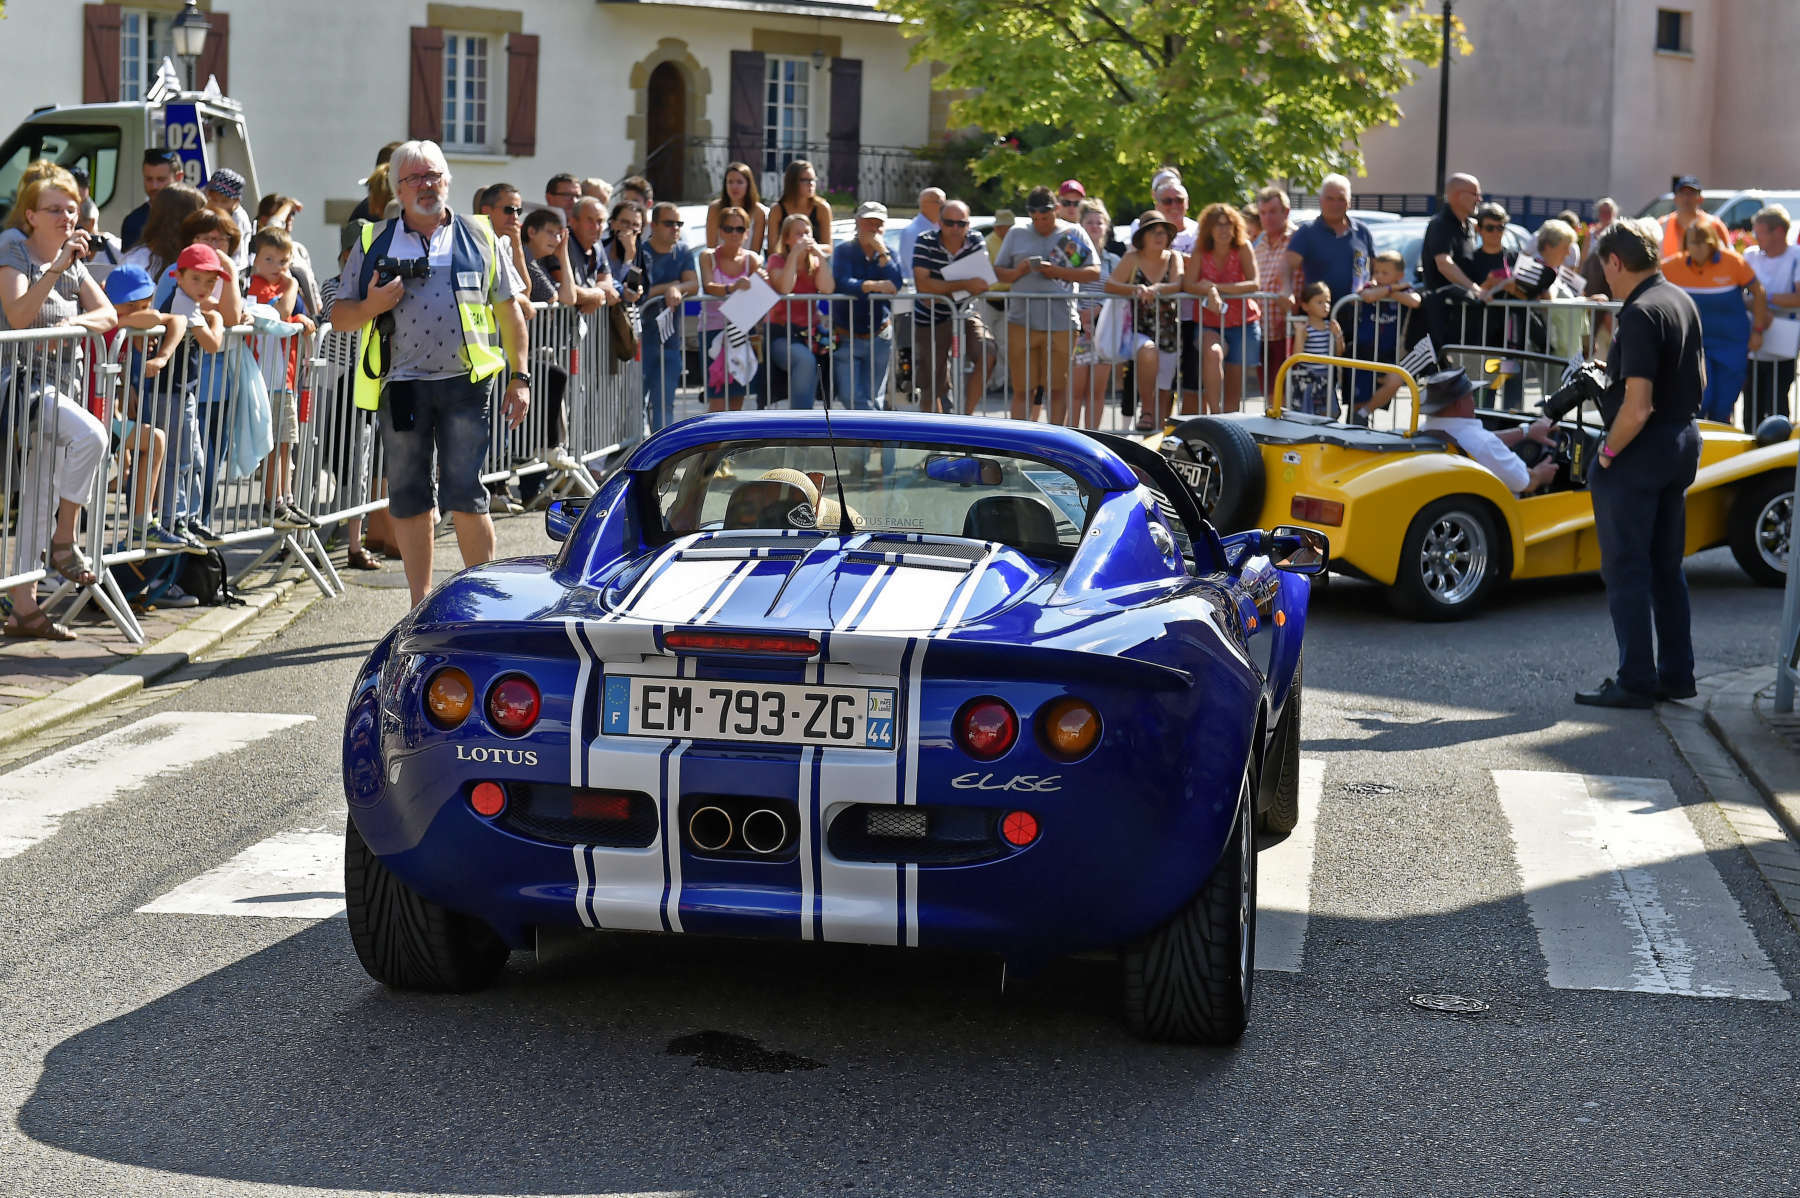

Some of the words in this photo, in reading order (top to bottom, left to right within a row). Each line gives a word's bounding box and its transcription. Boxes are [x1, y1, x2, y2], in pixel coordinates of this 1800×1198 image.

[168, 123, 198, 151] 02
[885, 517, 924, 527] FRANCE
[611, 711, 621, 725] F
[641, 685, 856, 740] EM-793-ZG
[868, 721, 891, 743] 44
[455, 744, 538, 766] LOTUS
[951, 772, 1062, 792] ELISE
